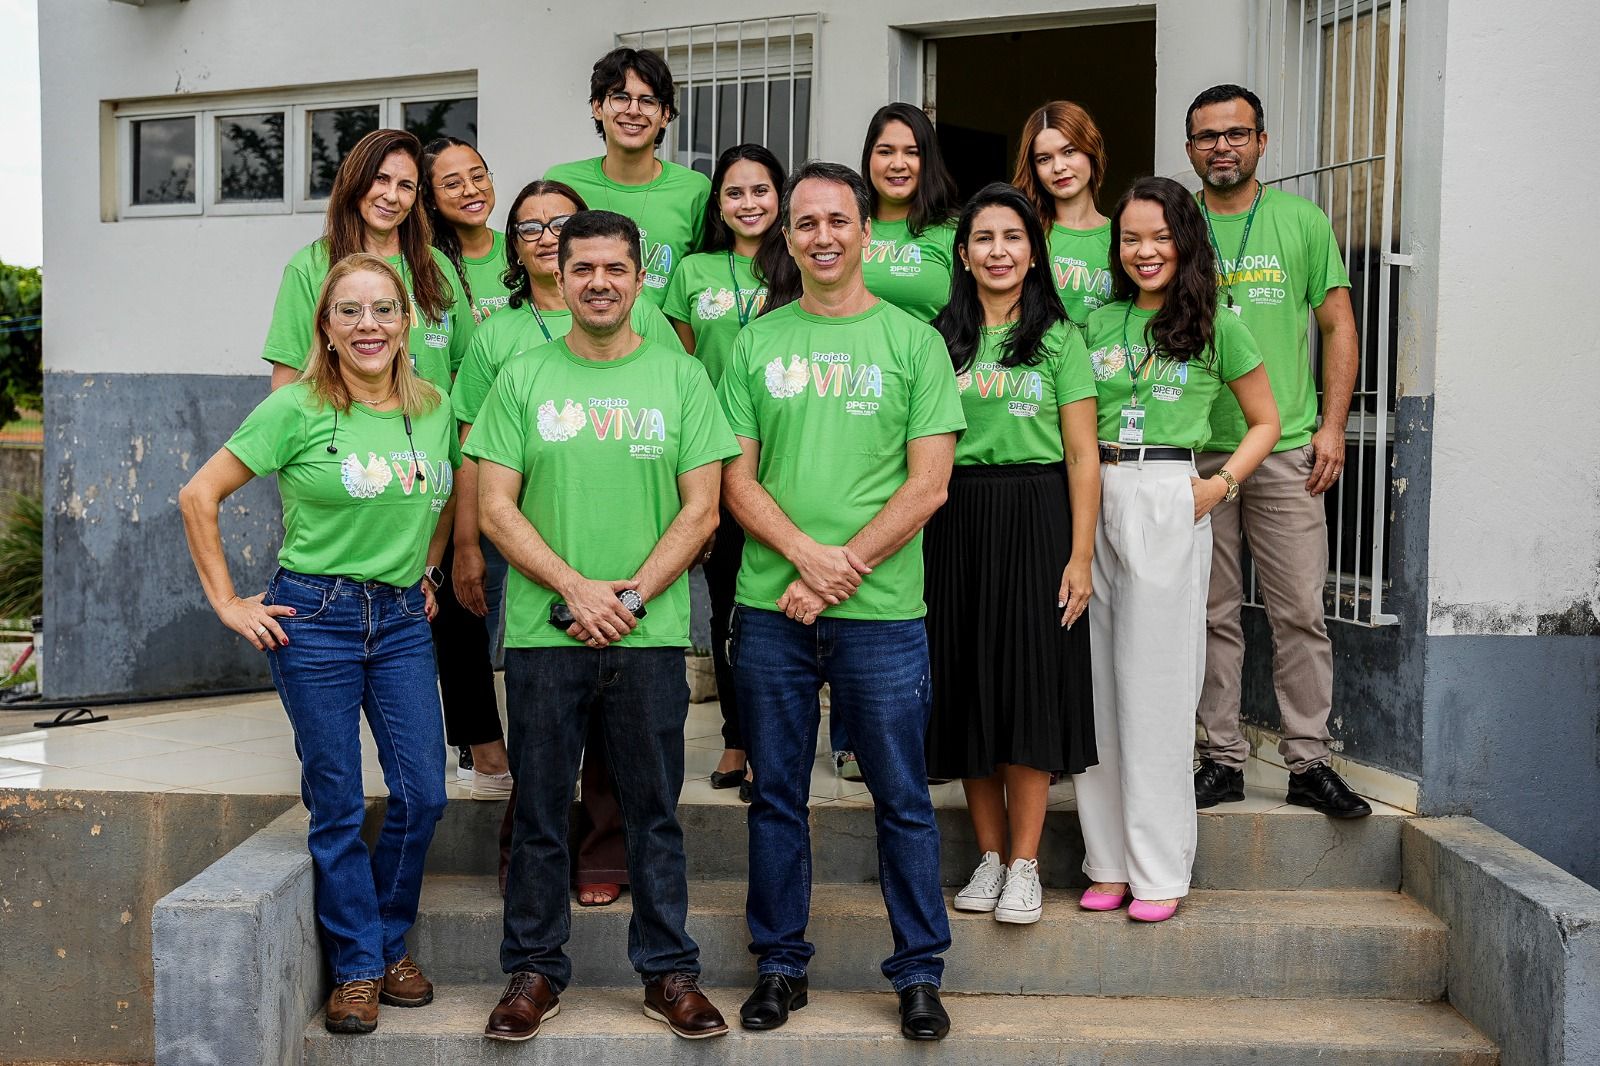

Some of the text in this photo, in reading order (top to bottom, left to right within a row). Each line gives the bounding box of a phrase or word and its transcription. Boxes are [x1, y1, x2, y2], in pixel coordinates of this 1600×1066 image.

[862, 242, 921, 264] VIVA
[1053, 262, 1112, 299] VIVA
[812, 352, 850, 364] Projeto
[812, 363, 882, 397] VIVA
[975, 371, 1042, 401] VIVA
[588, 398, 629, 409] Projeto
[589, 408, 665, 441] VIVA
[389, 450, 427, 461] Projeto
